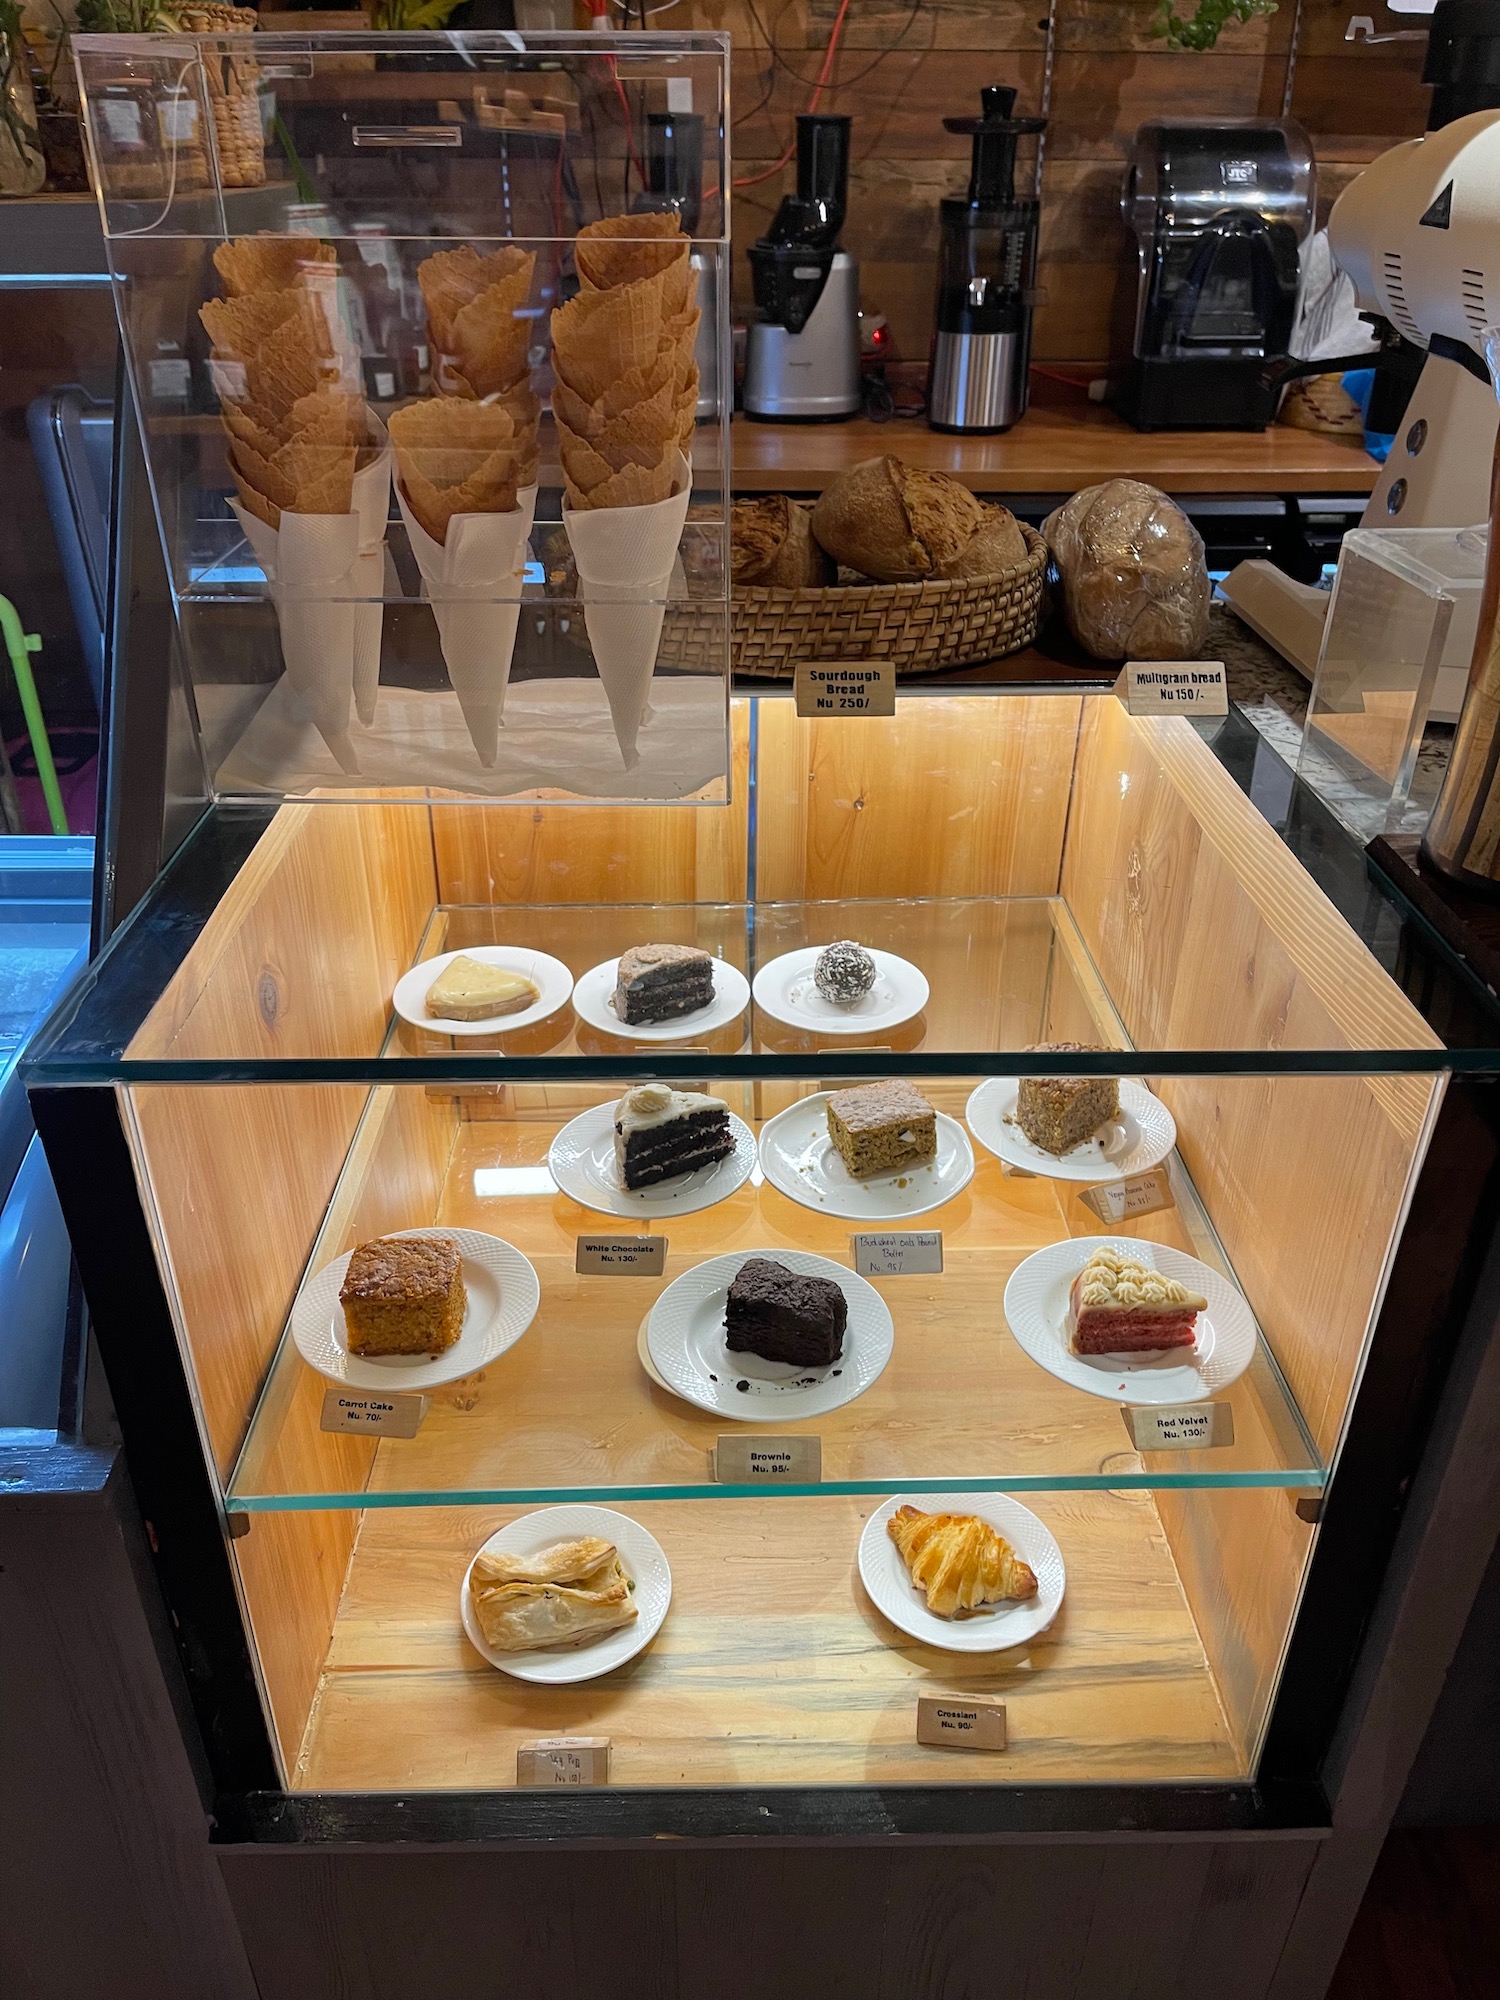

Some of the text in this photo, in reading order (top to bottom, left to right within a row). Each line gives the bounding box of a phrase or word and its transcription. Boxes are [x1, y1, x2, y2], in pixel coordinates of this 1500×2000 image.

[810, 670, 881, 681] Sourdough
[1137, 671, 1222, 685] Multigrain bread
[826, 684, 865, 694] Bread
[1160, 688, 1174, 700] Nu
[817, 698, 870, 709] Nu 250/
[338, 1399, 394, 1411] Carrot Cake
[365, 1413, 382, 1422] 70/-
[1157, 1416, 1209, 1428] Red Velvet
[1163, 1428, 1206, 1439] Nu. 130/-
[751, 1452, 791, 1461] Brownie
[752, 1465, 790, 1473] Nu. 95/-
[937, 1709, 977, 1720] Crossiant
[941, 1720, 974, 1730] Nu. 90/-
